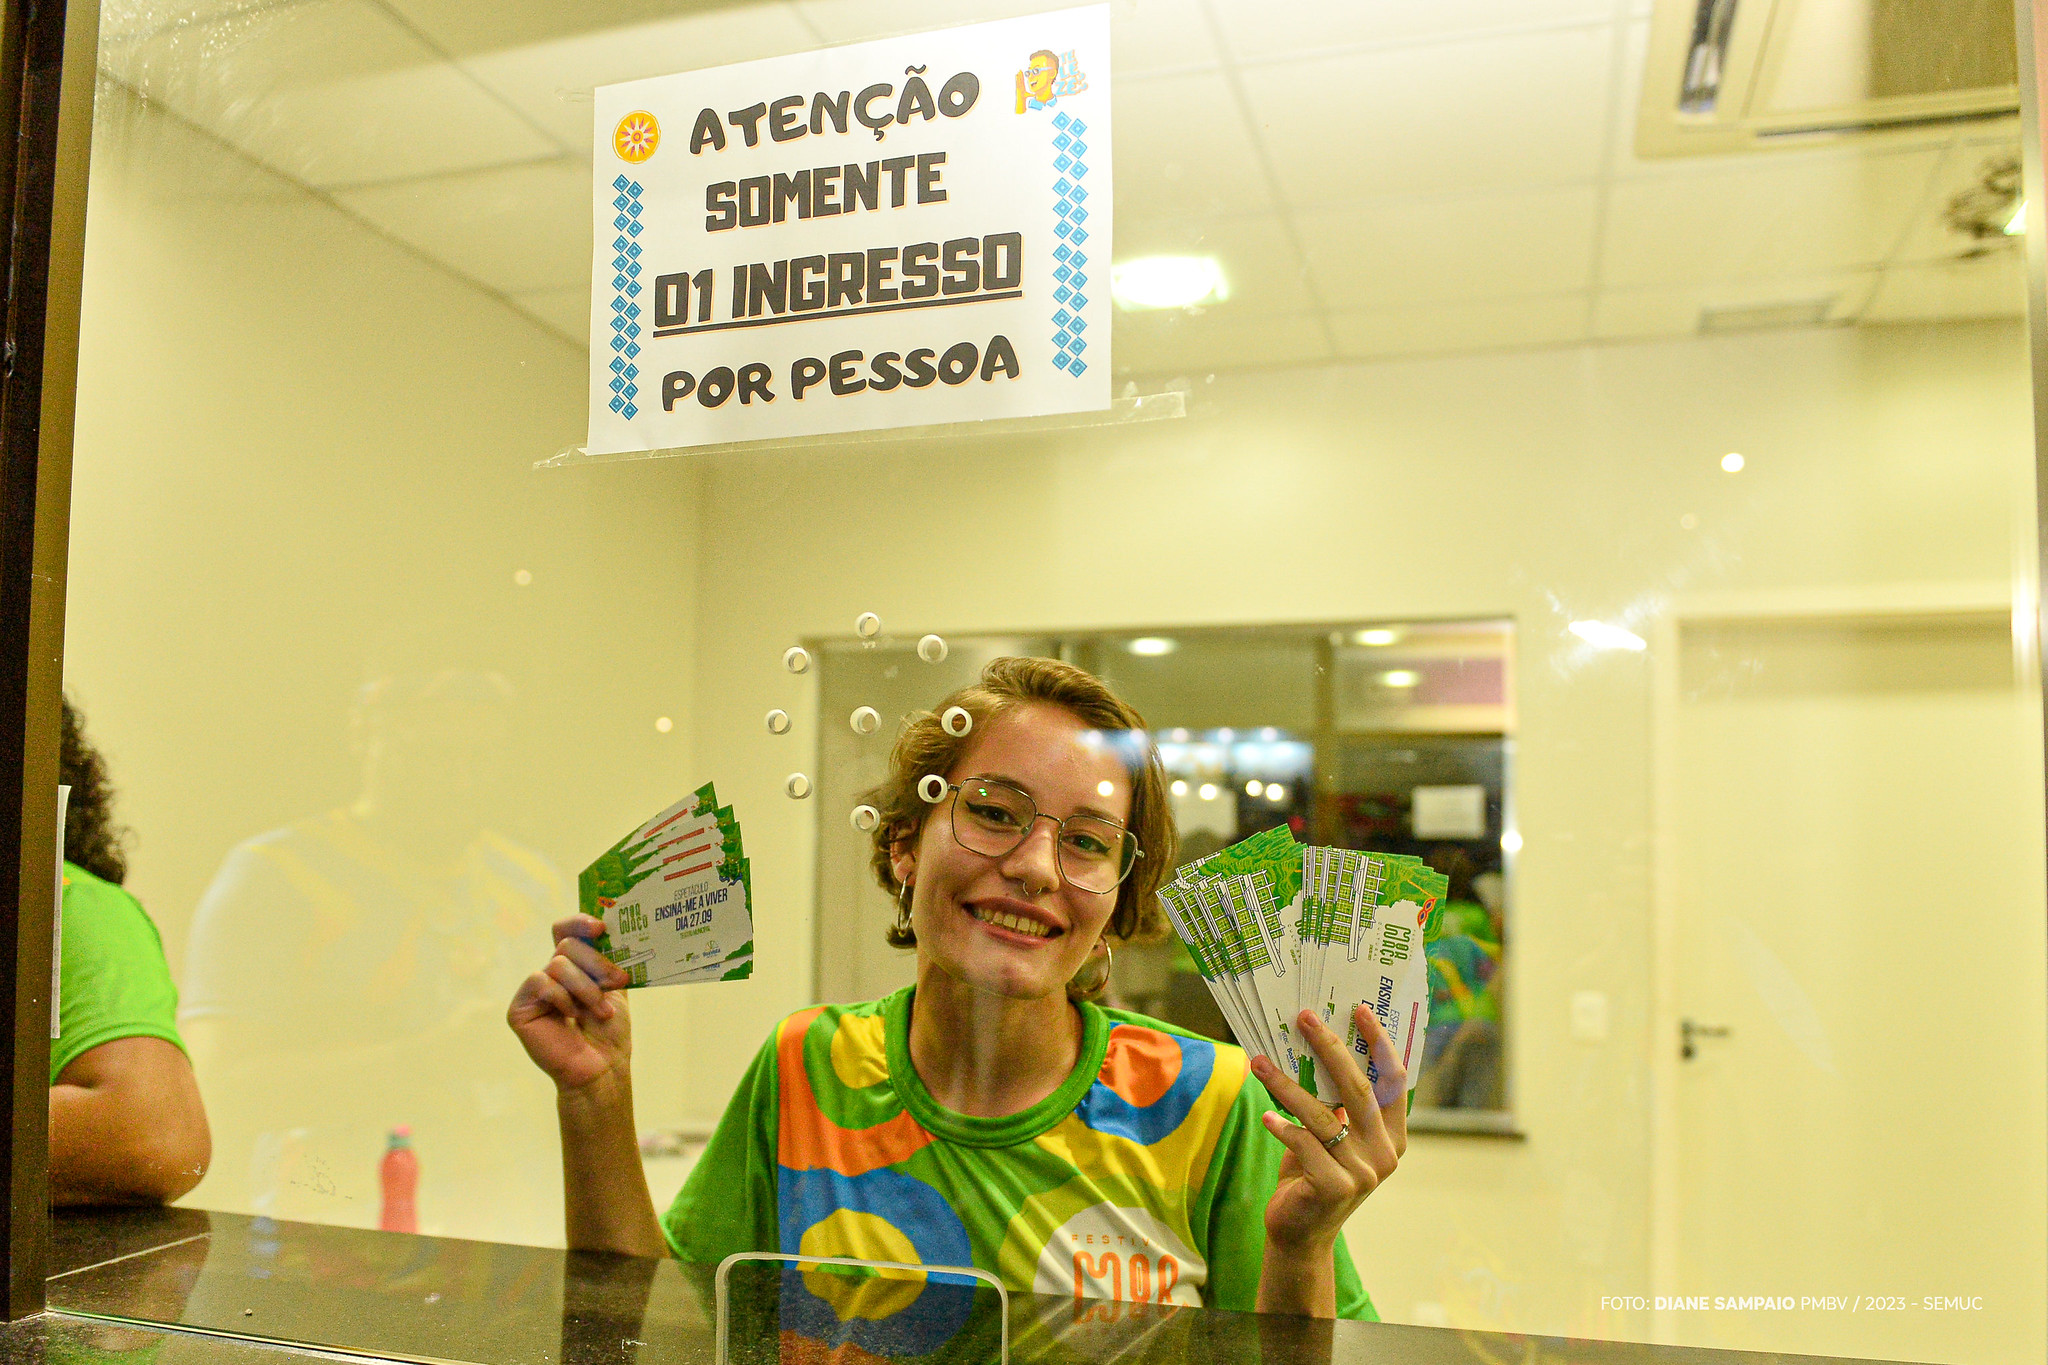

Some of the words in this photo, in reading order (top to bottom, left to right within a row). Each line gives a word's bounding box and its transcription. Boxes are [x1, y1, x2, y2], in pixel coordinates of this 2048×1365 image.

[690, 65, 981, 155] ATENÇÃO
[706, 152, 947, 233] SOMENTE
[654, 269, 713, 328] 01
[731, 232, 1022, 319] INGRESSO
[662, 362, 776, 412] POR
[791, 335, 1020, 400] PESSOA
[655, 896, 697, 922] ENSINA-ME
[698, 894, 704, 909] A
[705, 887, 728, 907] VIVER
[675, 914, 689, 932] DIA
[690, 908, 712, 928] 27.09
[1375, 975, 1394, 1028] ENSINA-
[1354, 1032, 1369, 1056] .09
